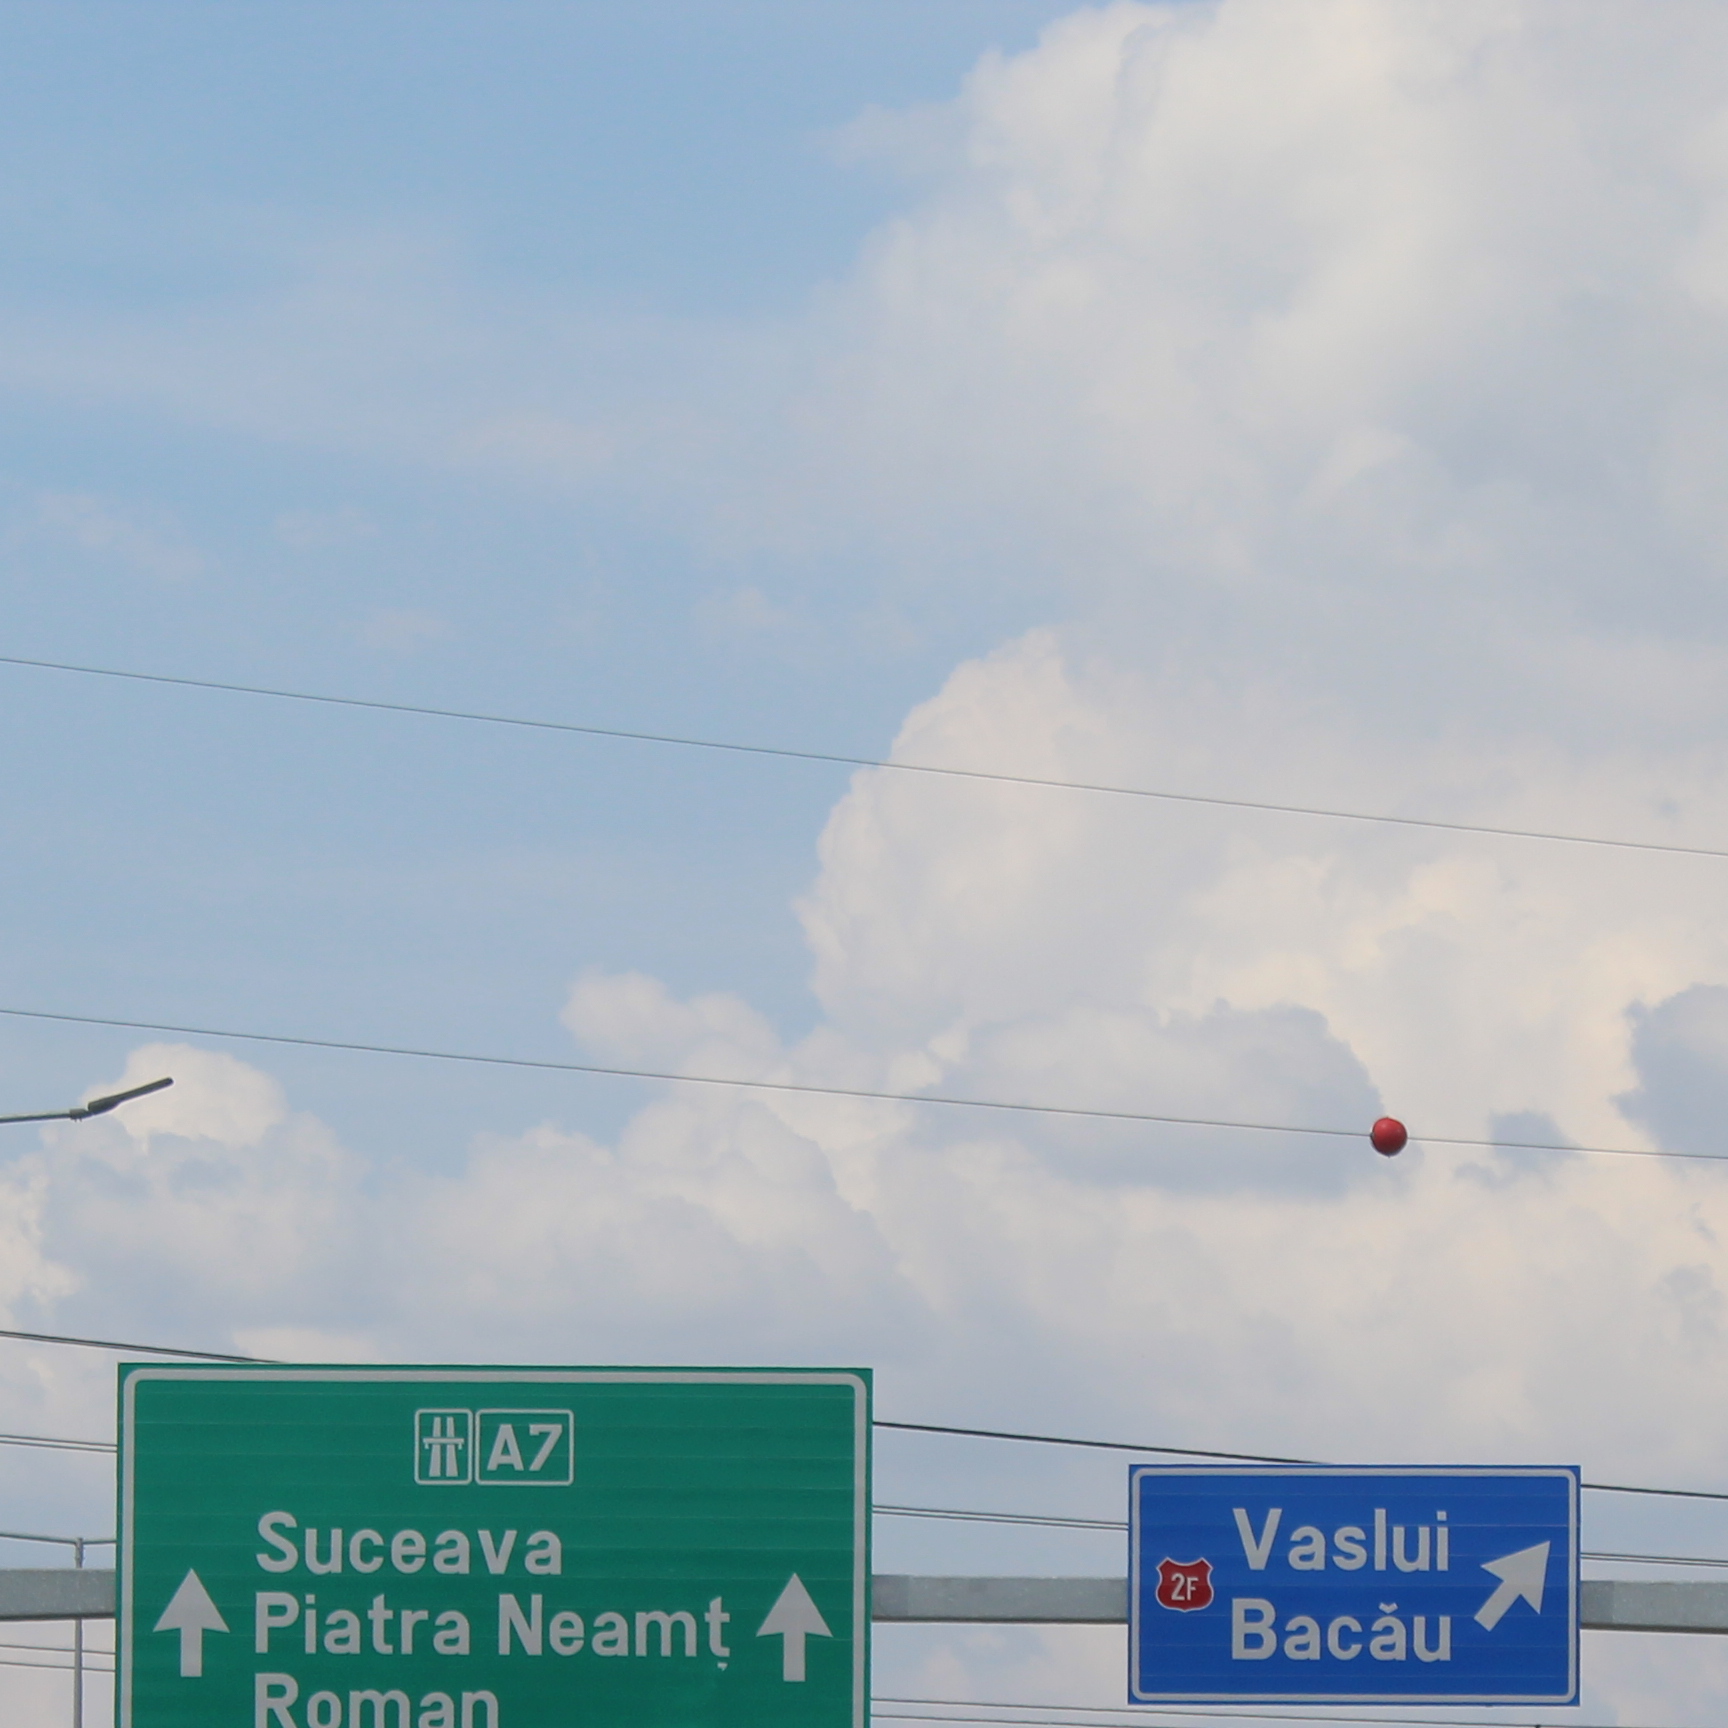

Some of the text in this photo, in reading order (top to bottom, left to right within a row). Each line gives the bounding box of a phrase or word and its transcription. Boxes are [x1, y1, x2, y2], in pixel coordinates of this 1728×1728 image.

[486, 1423, 563, 1472] A7
[255, 1510, 563, 1577] Suceava
[1231, 1507, 1450, 1573] Vaslui
[1171, 1573, 1200, 1601] 2F
[253, 1591, 732, 1672] Piatra Neamț
[1231, 1597, 1452, 1662] Bacău
